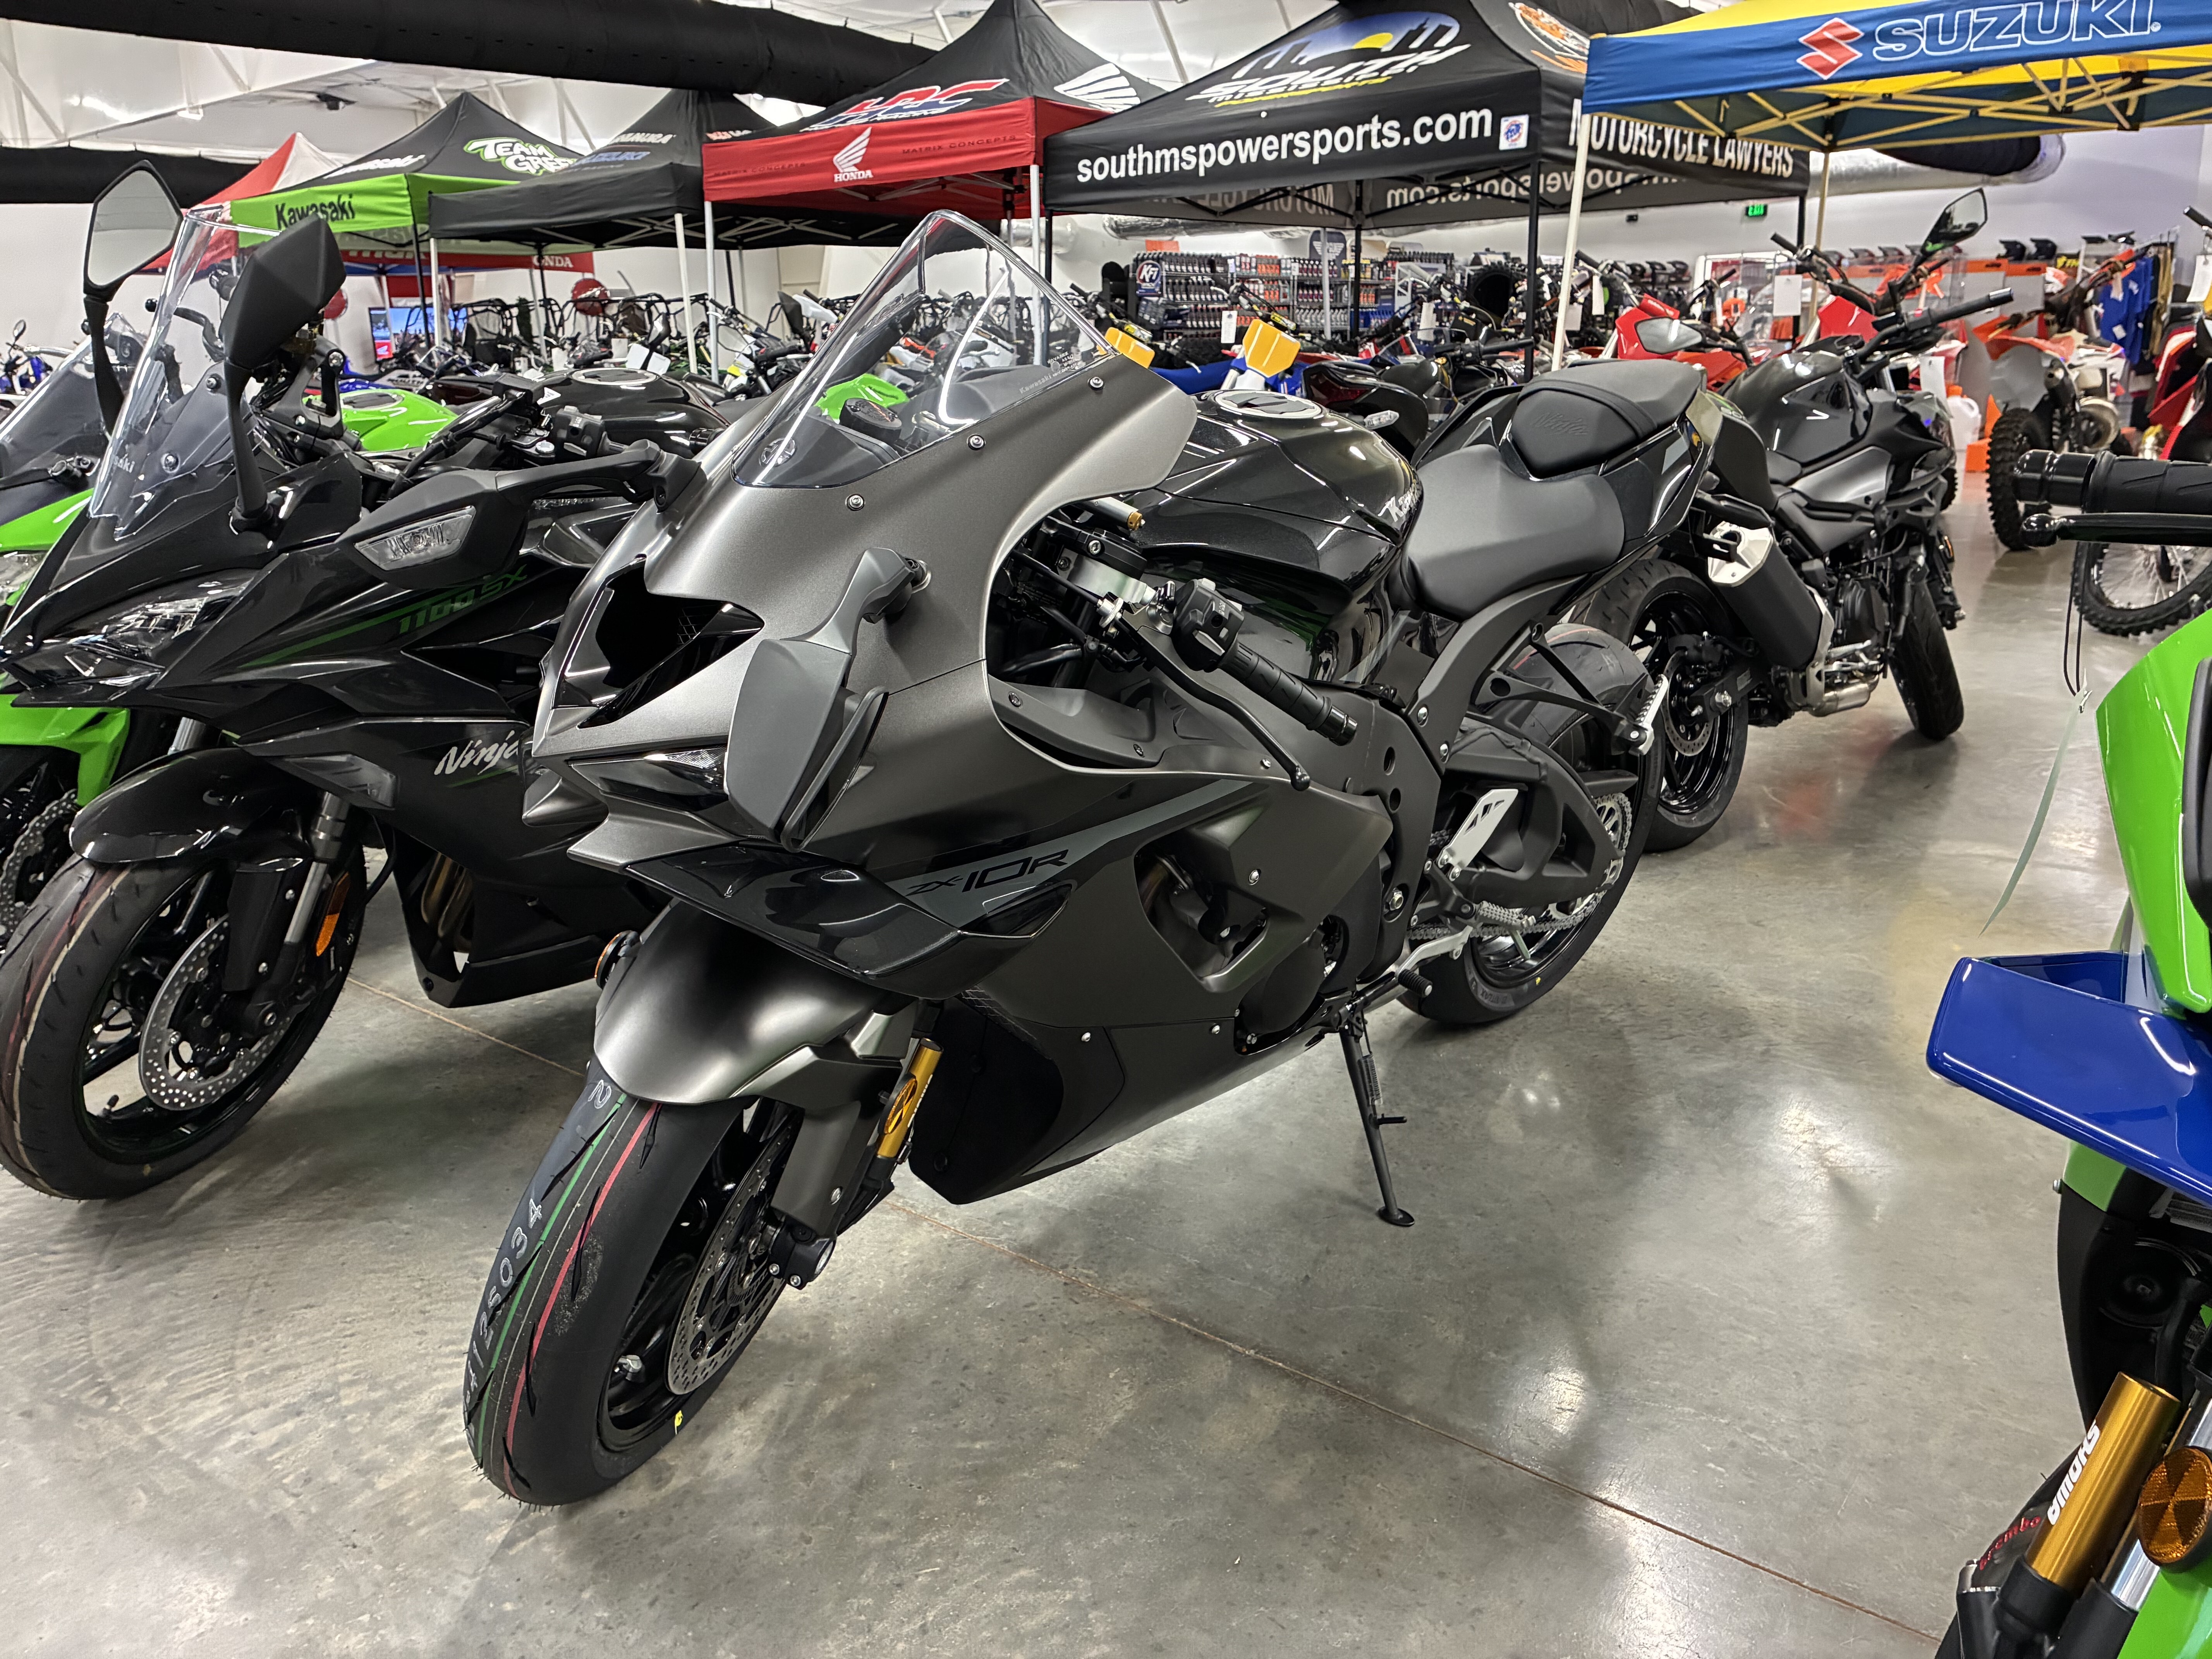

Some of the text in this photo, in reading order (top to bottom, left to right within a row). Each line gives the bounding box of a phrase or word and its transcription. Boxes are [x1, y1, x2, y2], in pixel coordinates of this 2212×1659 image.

[1873, 0, 2154, 62] SUZUKI
[1185, 44, 1471, 101] SOUTH
[467, 138, 555, 160] TEAM
[505, 154, 574, 174] GREE
[902, 135, 1017, 154] MATRIX CONCEPTS
[1076, 108, 1492, 183] southmspowersports.com
[1712, 136, 1795, 178] LAWYERS
[834, 169, 874, 182] HONDA
[275, 193, 356, 231] Kawasaki
[533, 255, 574, 268] ONDA
[1019, 373, 1051, 394] Kawasaki
[434, 730, 520, 776] Ninja
[905, 849, 1069, 896] ZX-10R
[2047, 1420, 2101, 1525] SHOWA
